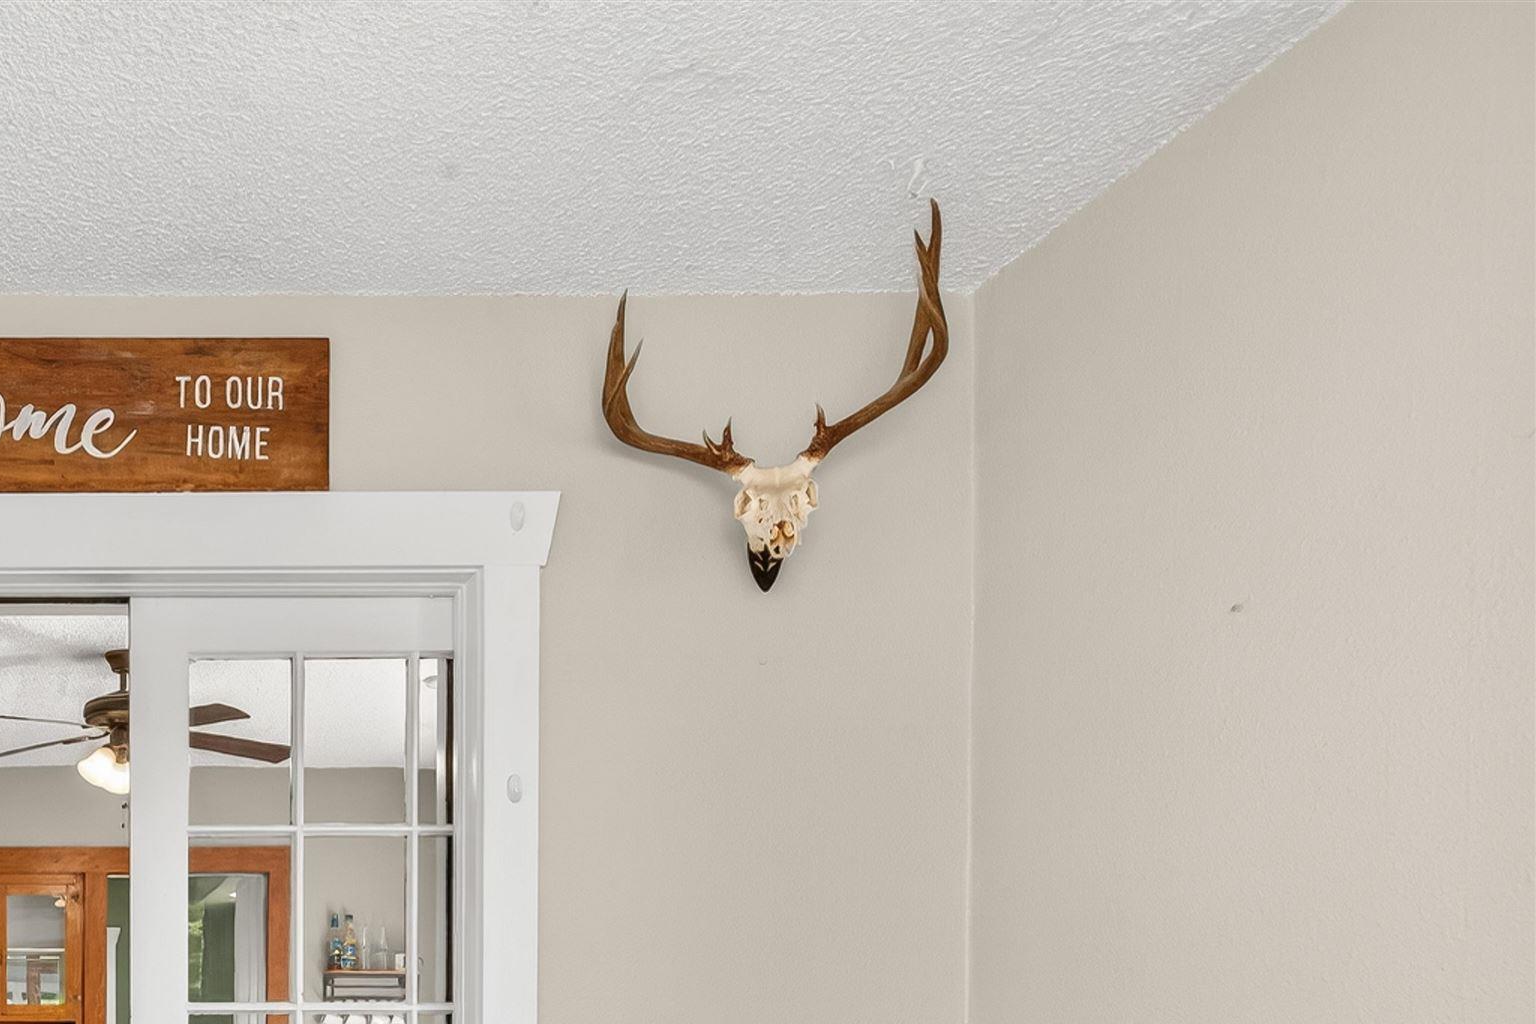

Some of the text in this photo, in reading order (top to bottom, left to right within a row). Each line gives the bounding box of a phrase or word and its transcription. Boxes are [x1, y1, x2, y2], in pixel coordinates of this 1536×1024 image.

[175, 375, 284, 411] TO OUR
[186, 424, 270, 460] HOME
